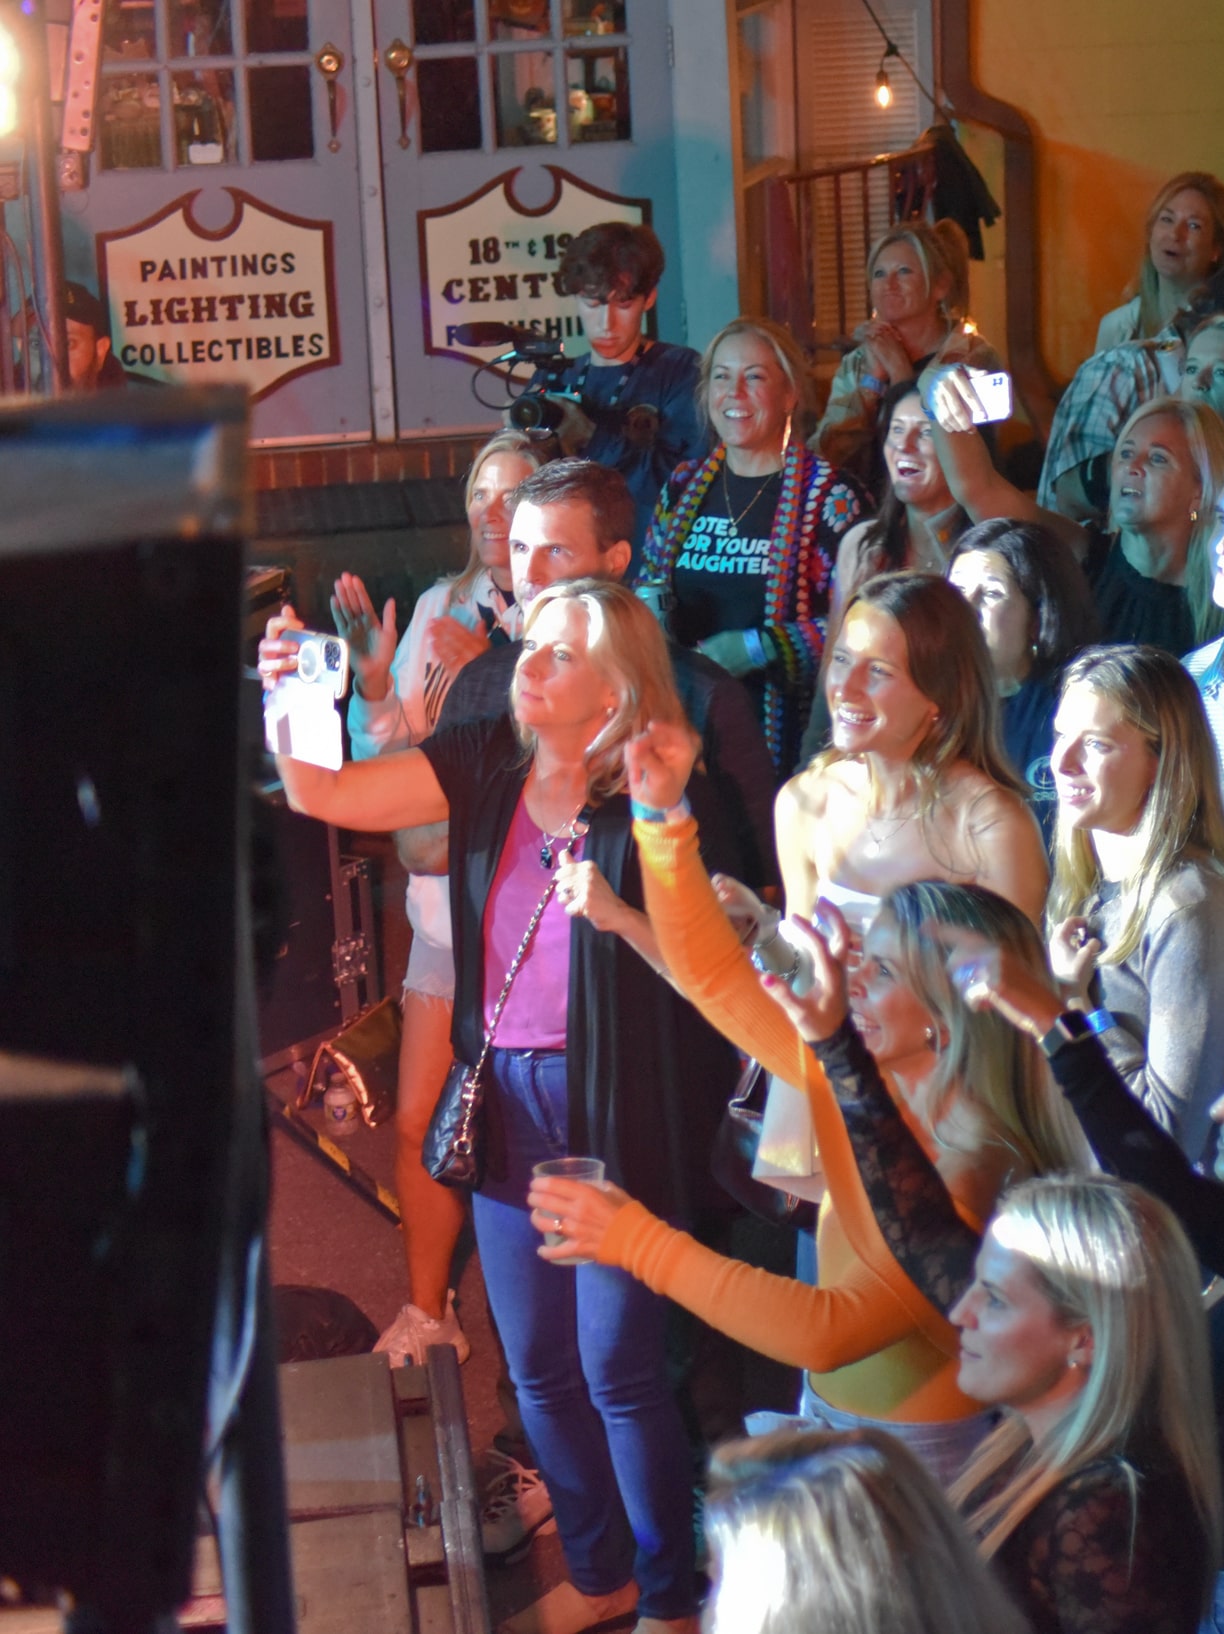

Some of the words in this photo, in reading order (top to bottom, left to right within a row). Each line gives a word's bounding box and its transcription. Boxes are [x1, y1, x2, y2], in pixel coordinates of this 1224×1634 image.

[139, 252, 296, 283] PAINTINGS
[123, 291, 315, 327] LIGHTING
[121, 333, 324, 367] COLLECTIBLES
[692, 516, 730, 536] OTE
[682, 533, 711, 552] OR
[716, 537, 771, 555] YOUR
